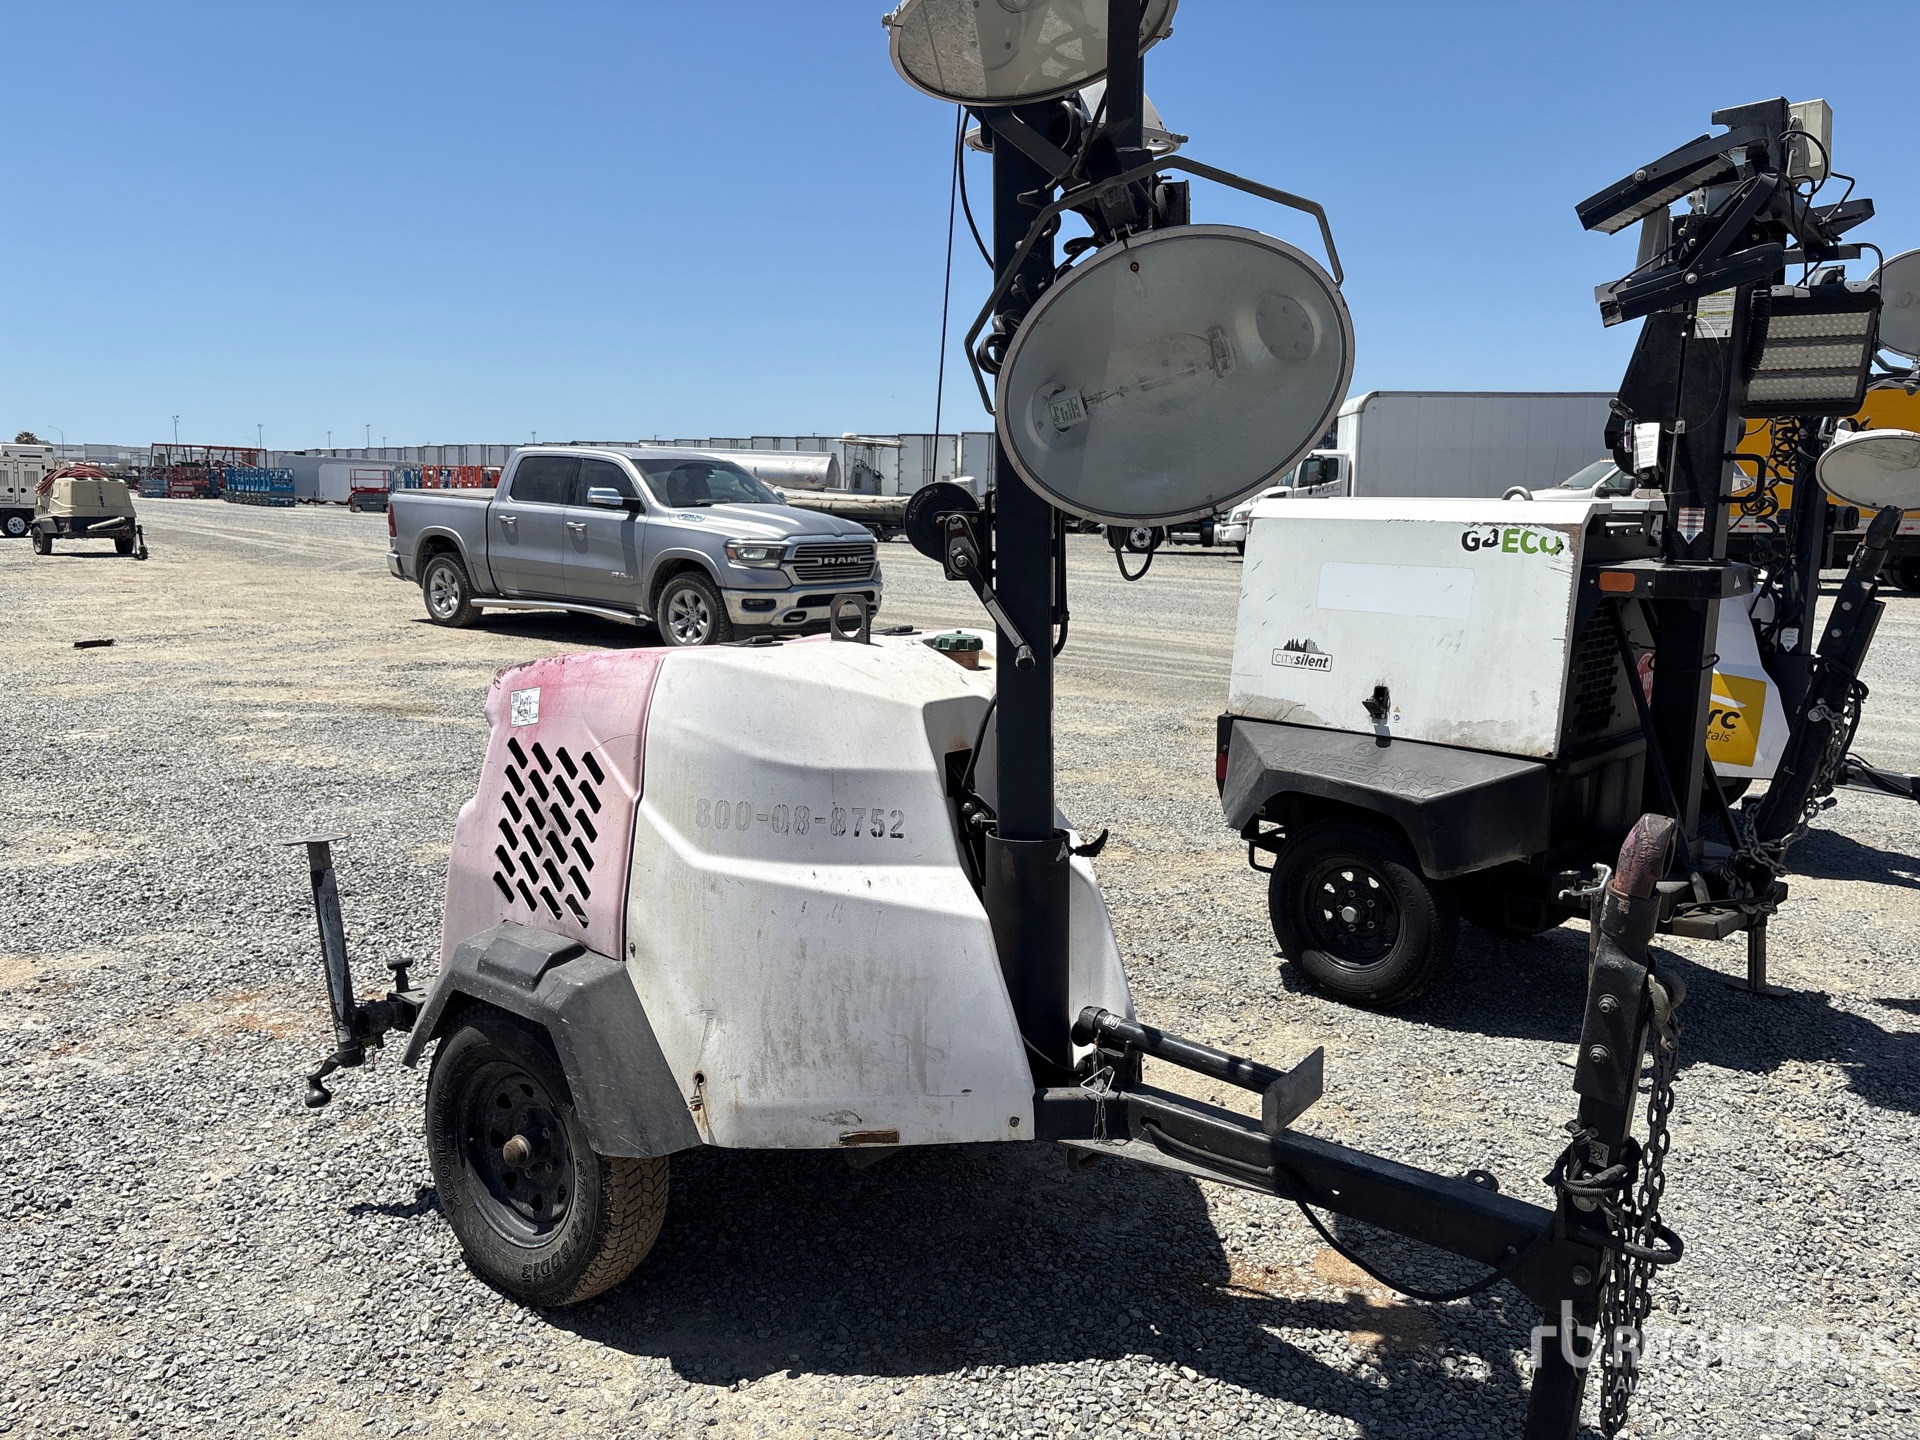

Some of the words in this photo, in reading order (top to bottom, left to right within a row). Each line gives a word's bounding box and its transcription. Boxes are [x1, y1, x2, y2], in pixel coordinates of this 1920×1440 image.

[824, 556, 858, 565] RAM
[1275, 653, 1329, 668] CITYsilent
[1707, 709, 1741, 729] rc
[1705, 730, 1732, 743] tals
[696, 799, 905, 839] 800-08-8752
